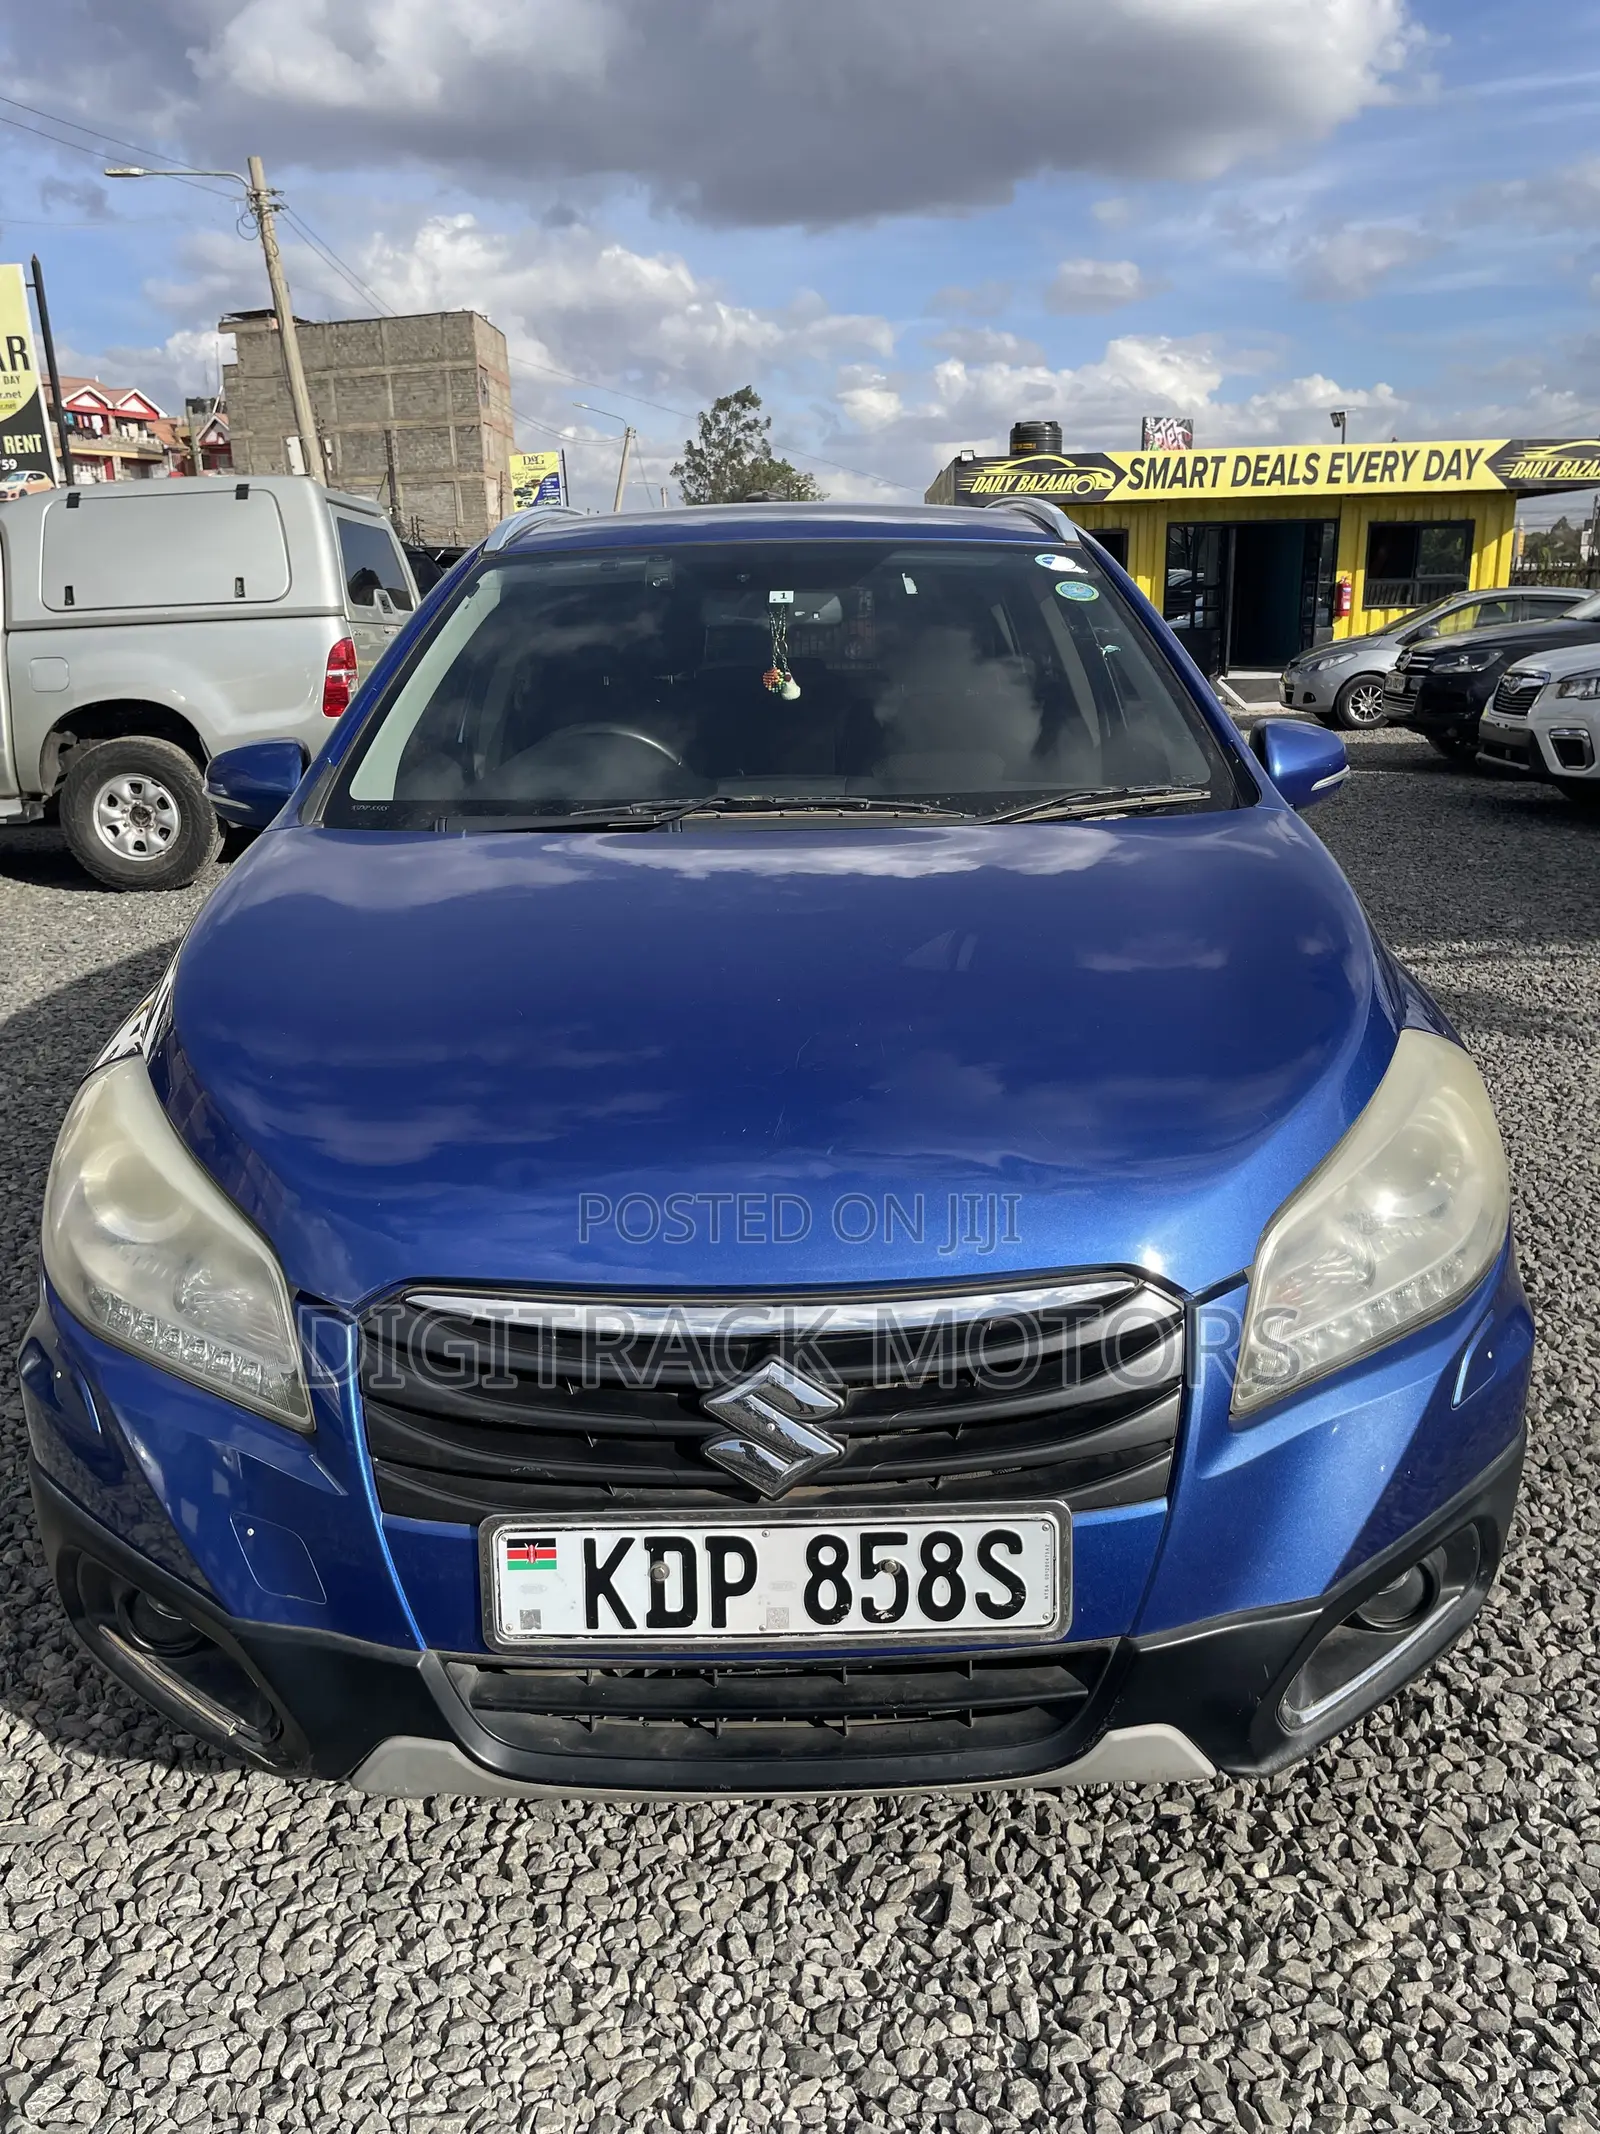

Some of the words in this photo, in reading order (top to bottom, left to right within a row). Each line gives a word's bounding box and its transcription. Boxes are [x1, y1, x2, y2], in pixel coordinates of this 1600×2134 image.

[0, 335, 31, 372] R
[3, 375, 21, 385] DAY
[2, 434, 42, 454] RENT
[0, 458, 18, 470] 59
[1127, 456, 1226, 490] SMART
[1230, 453, 1321, 487] DEALS
[1326, 450, 1420, 486] EVERY
[1423, 448, 1485, 481] DAY
[1509, 460, 1558, 478] DAILY
[970, 475, 1017, 493] DAILY
[1014, 473, 1078, 492] BAZAAR
[584, 1535, 759, 1630] KDP
[803, 1528, 1026, 1626] 858S
